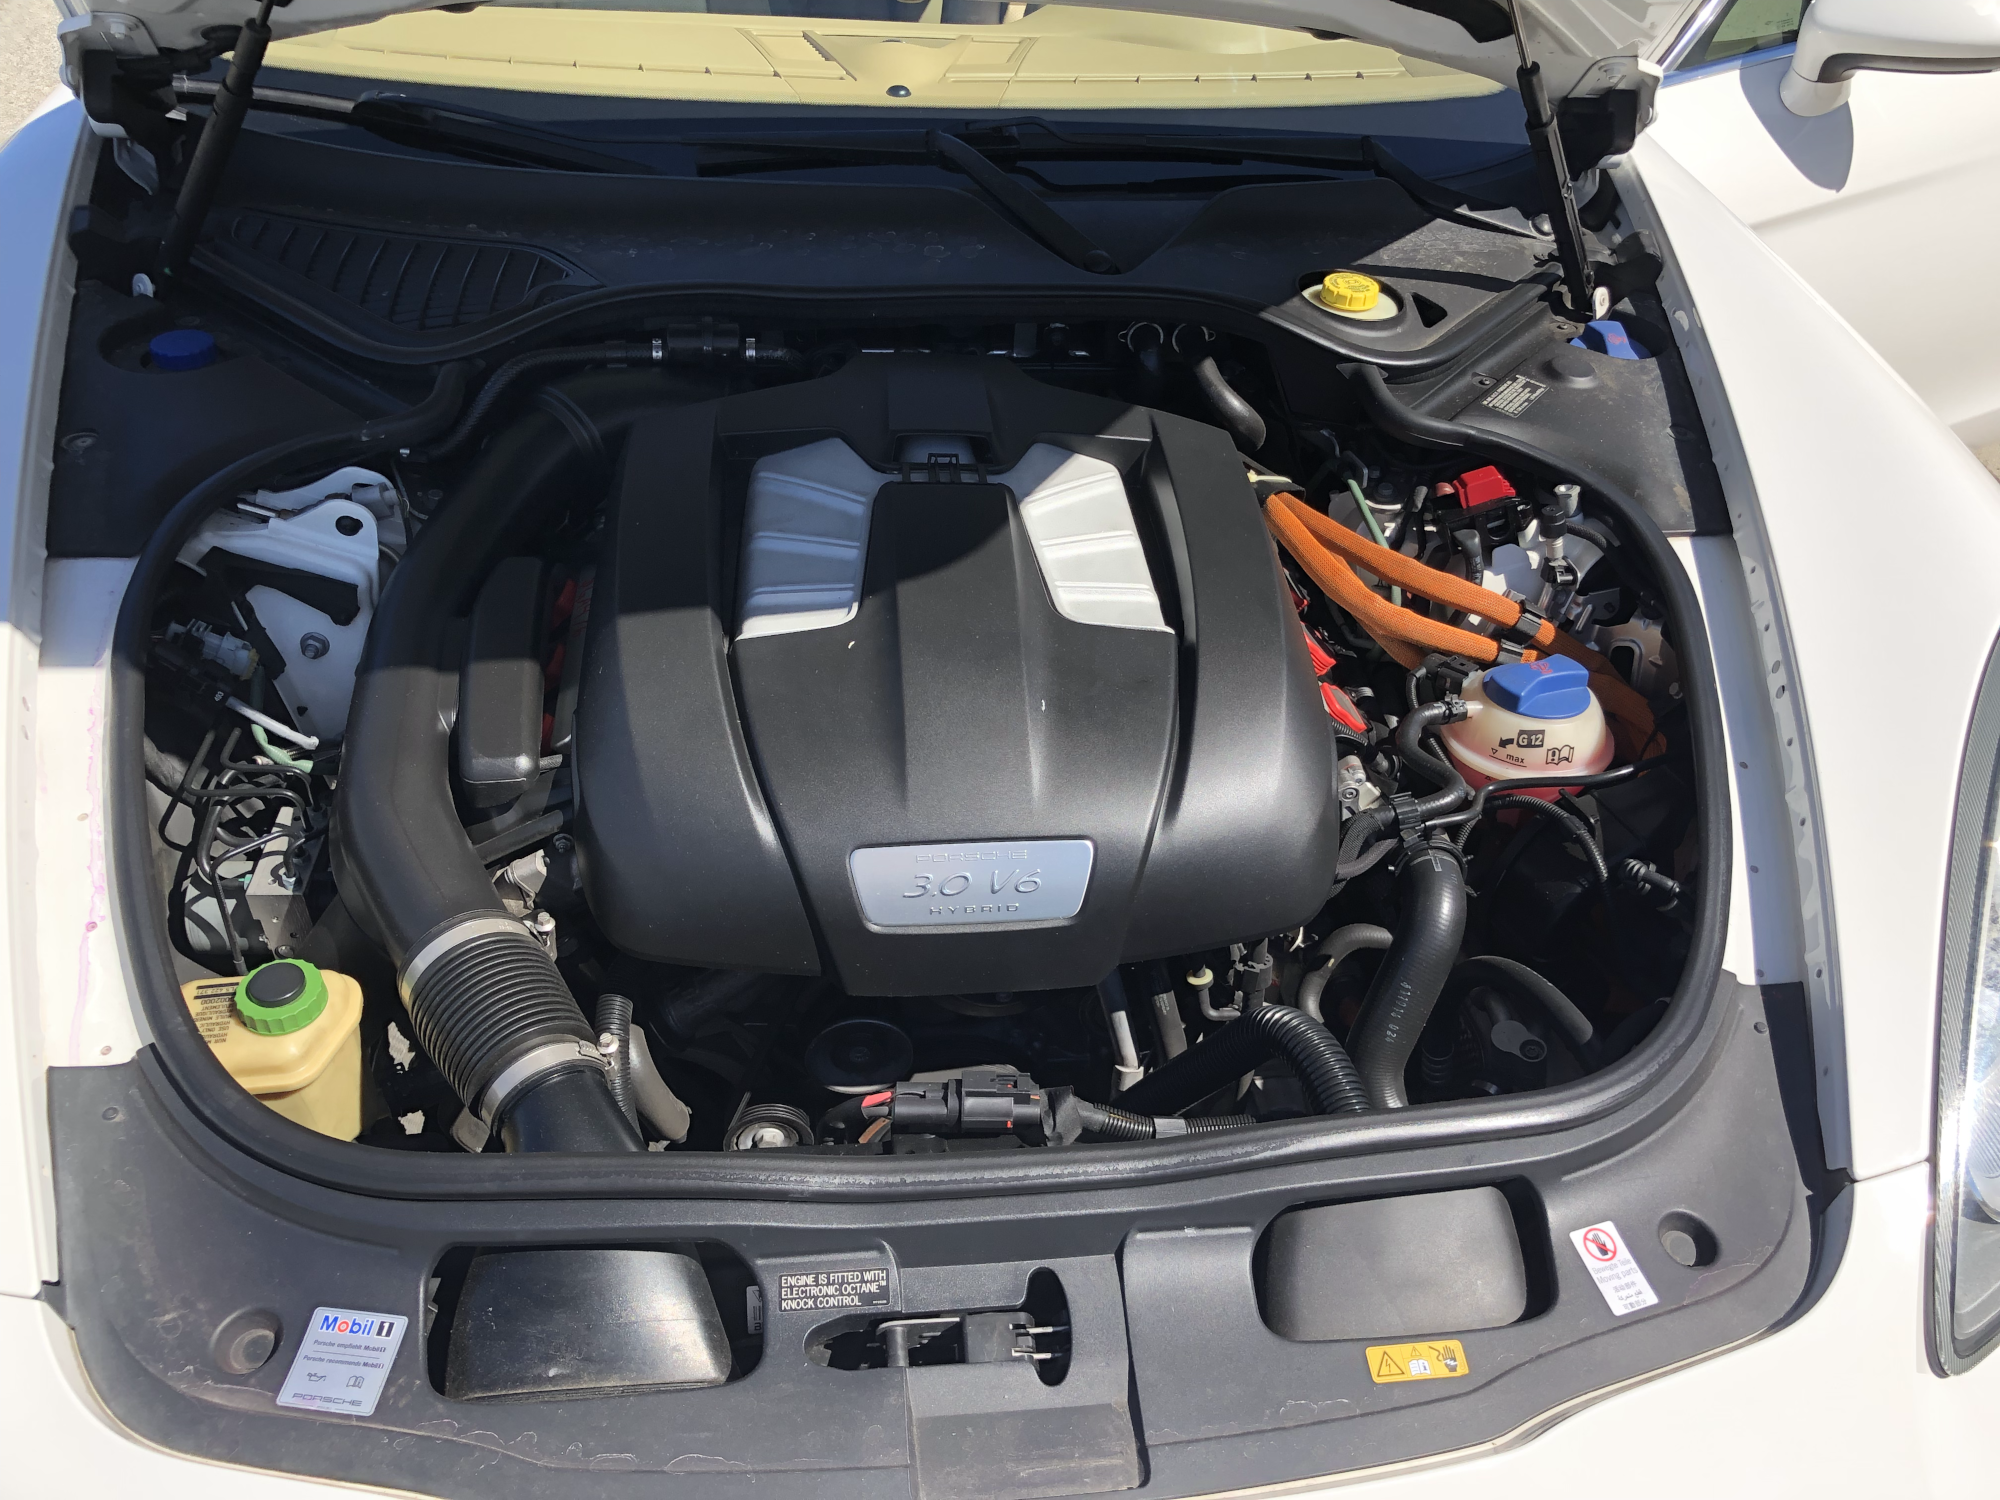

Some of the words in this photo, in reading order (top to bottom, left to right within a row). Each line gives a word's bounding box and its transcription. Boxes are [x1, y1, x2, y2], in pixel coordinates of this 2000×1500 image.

[1518, 734, 1528, 746] G
[1530, 733, 1543, 745] 12
[1506, 753, 1525, 764] max
[916, 850, 1028, 863] PORSCHE
[902, 871, 973, 899] 3.0
[989, 868, 1042, 895] V6
[929, 902, 1020, 916] HYBRID
[1592, 1263, 1618, 1275] Bewegte
[1596, 1273, 1622, 1285] Moving
[1621, 1267, 1639, 1279] parts
[781, 1274, 816, 1287] ENGINE
[819, 1273, 828, 1285] IS
[830, 1271, 861, 1284] FITTED
[863, 1269, 887, 1281] WITH
[781, 1285, 840, 1299] ELECTRONIC
[781, 1298, 815, 1311] KNOCK
[817, 1295, 862, 1308] CONTROL
[319, 1314, 375, 1336] Mobil
[313, 1339, 336, 1348] Porsche
[336, 1342, 363, 1350] empfiehlt
[302, 1354, 326, 1363] Porsche
[325, 1359, 361, 1367] recommends
[291, 1392, 363, 1407] PORSCHE
